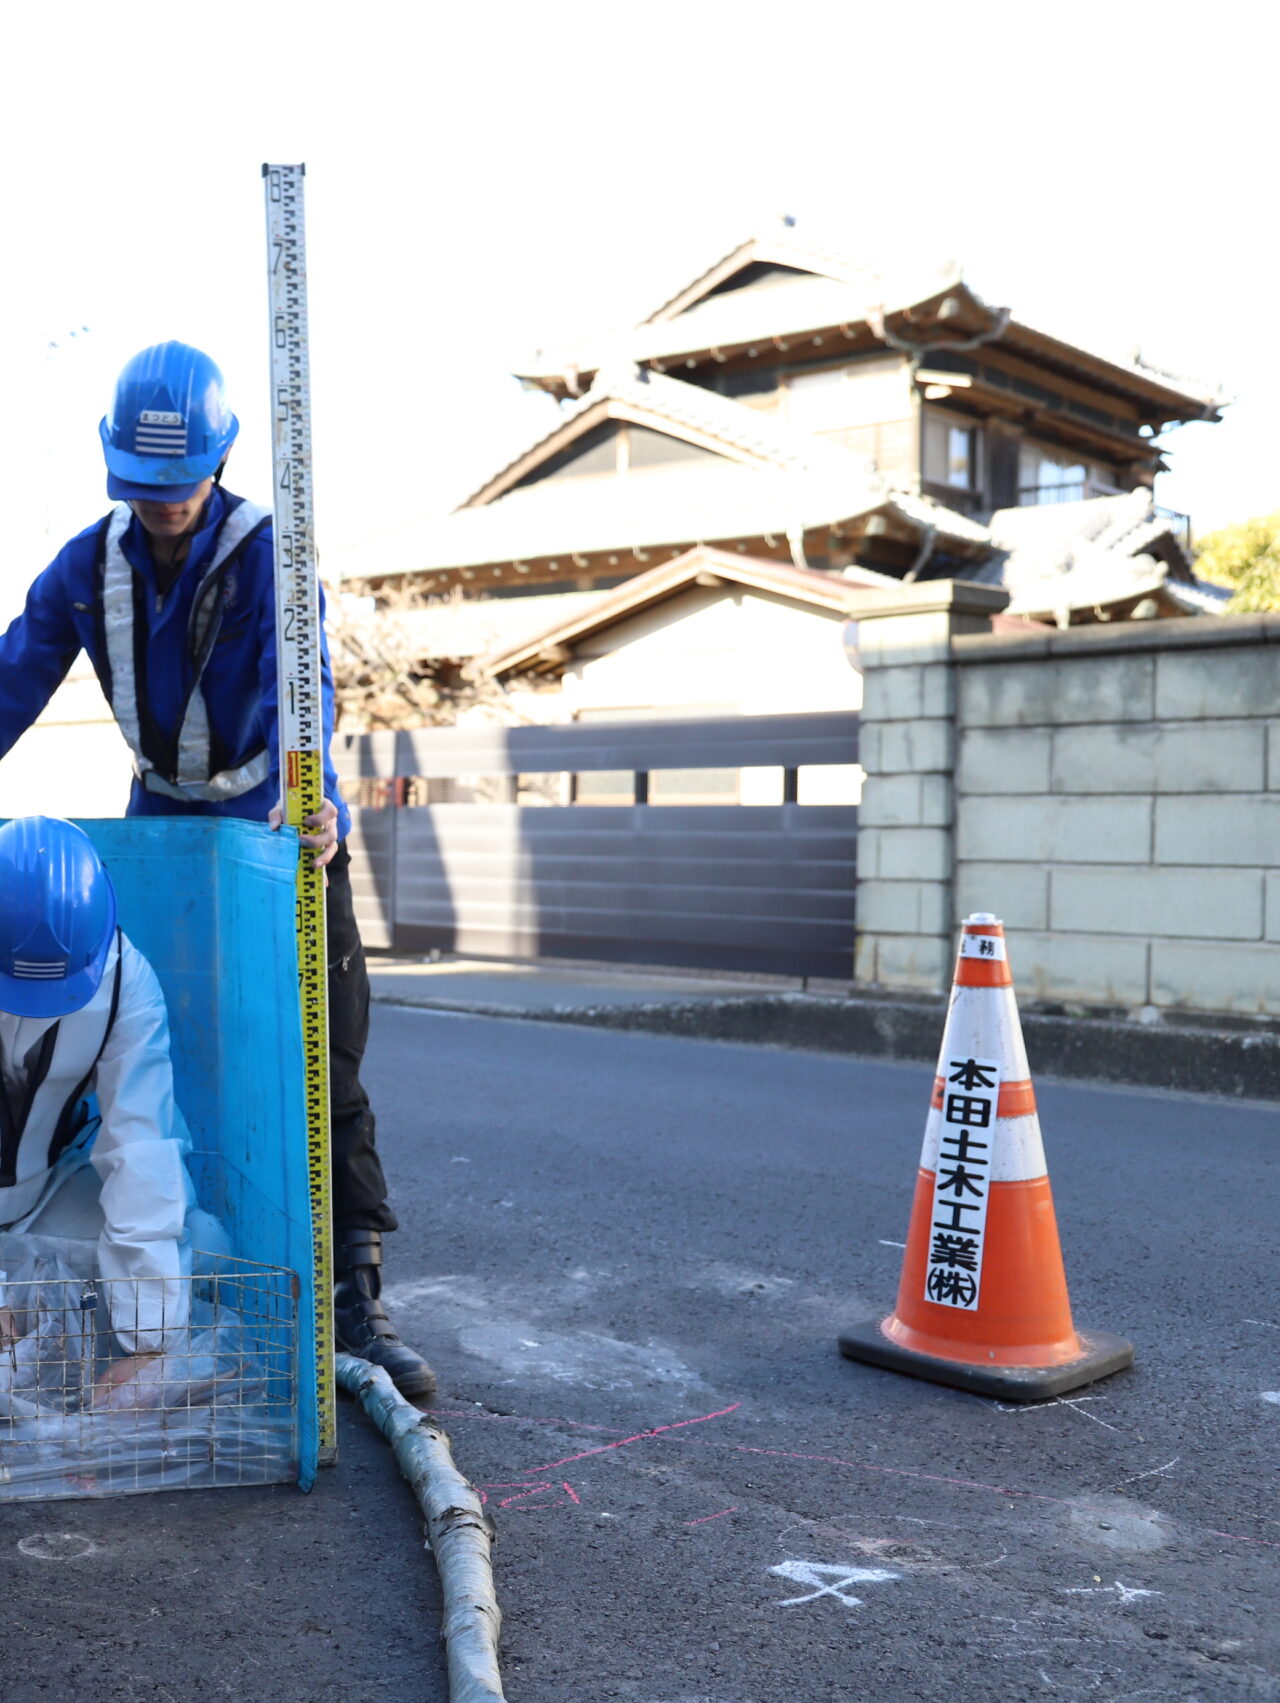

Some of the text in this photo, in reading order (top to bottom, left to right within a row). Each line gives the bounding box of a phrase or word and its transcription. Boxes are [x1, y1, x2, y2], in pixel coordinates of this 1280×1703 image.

[271, 170, 281, 202] 8
[273, 242, 283, 275] 7
[275, 316, 286, 348] 6
[277, 389, 289, 421] 5
[280, 462, 292, 495] 4
[282, 535, 293, 567] 3
[284, 607, 295, 641] 2
